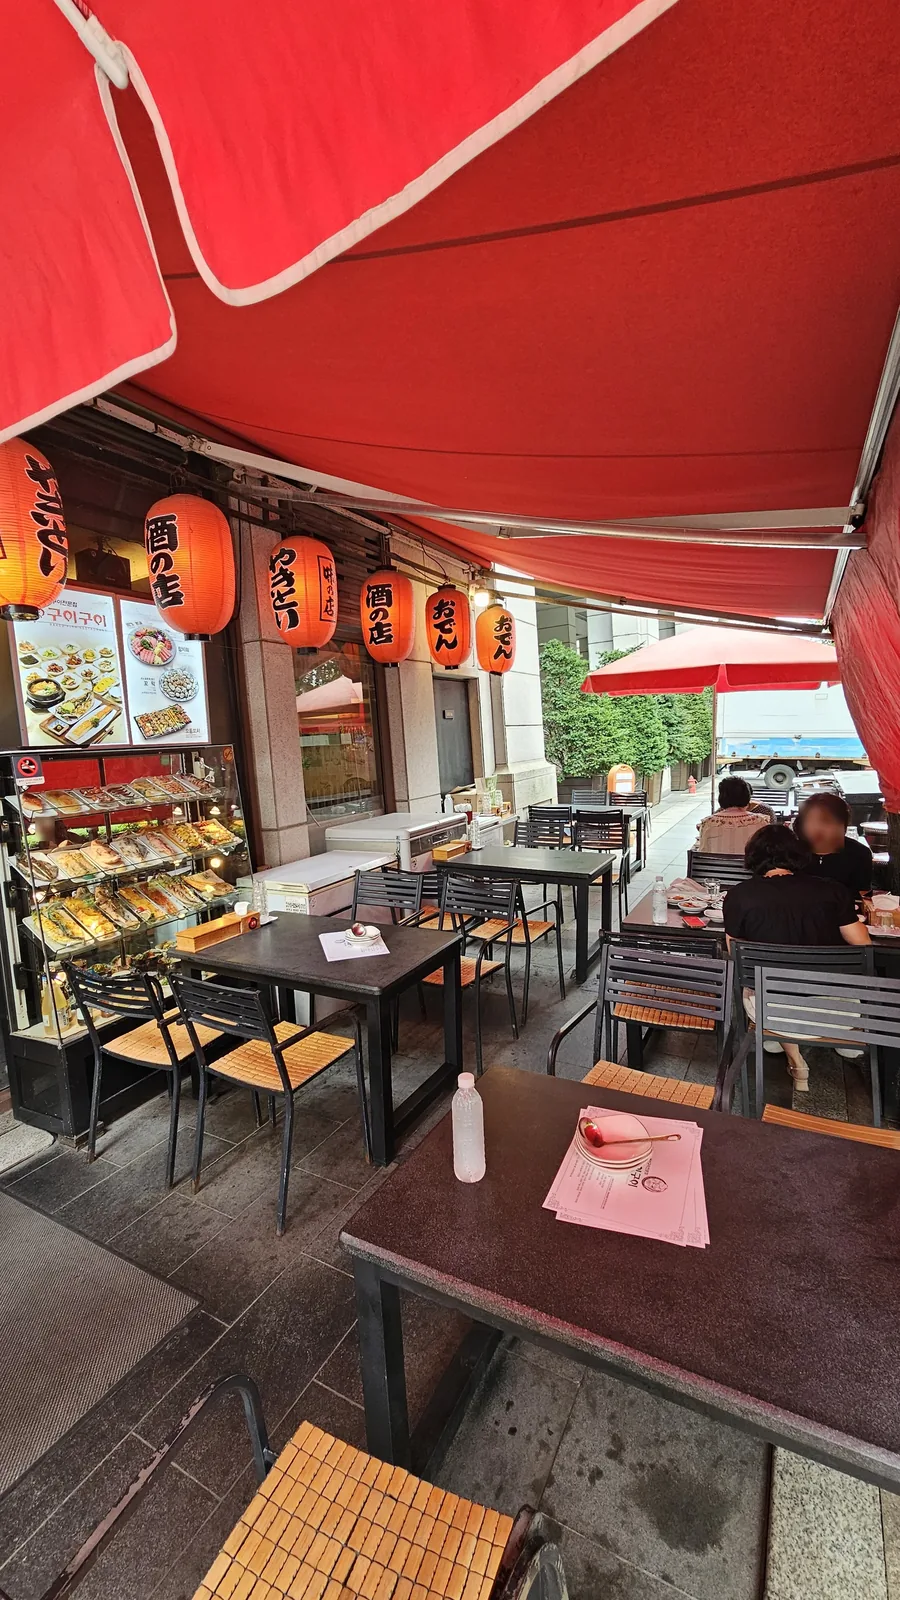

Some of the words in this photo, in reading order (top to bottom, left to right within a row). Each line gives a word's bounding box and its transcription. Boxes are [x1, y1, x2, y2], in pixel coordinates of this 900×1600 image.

[146, 513, 184, 610] 酒の店
[269, 547, 300, 633] やきとり
[47, 607, 107, 628] 구이구이
[366, 583, 394, 645] 酒の店
[432, 598, 458, 652] おでん
[493, 614, 513, 660] おでん
